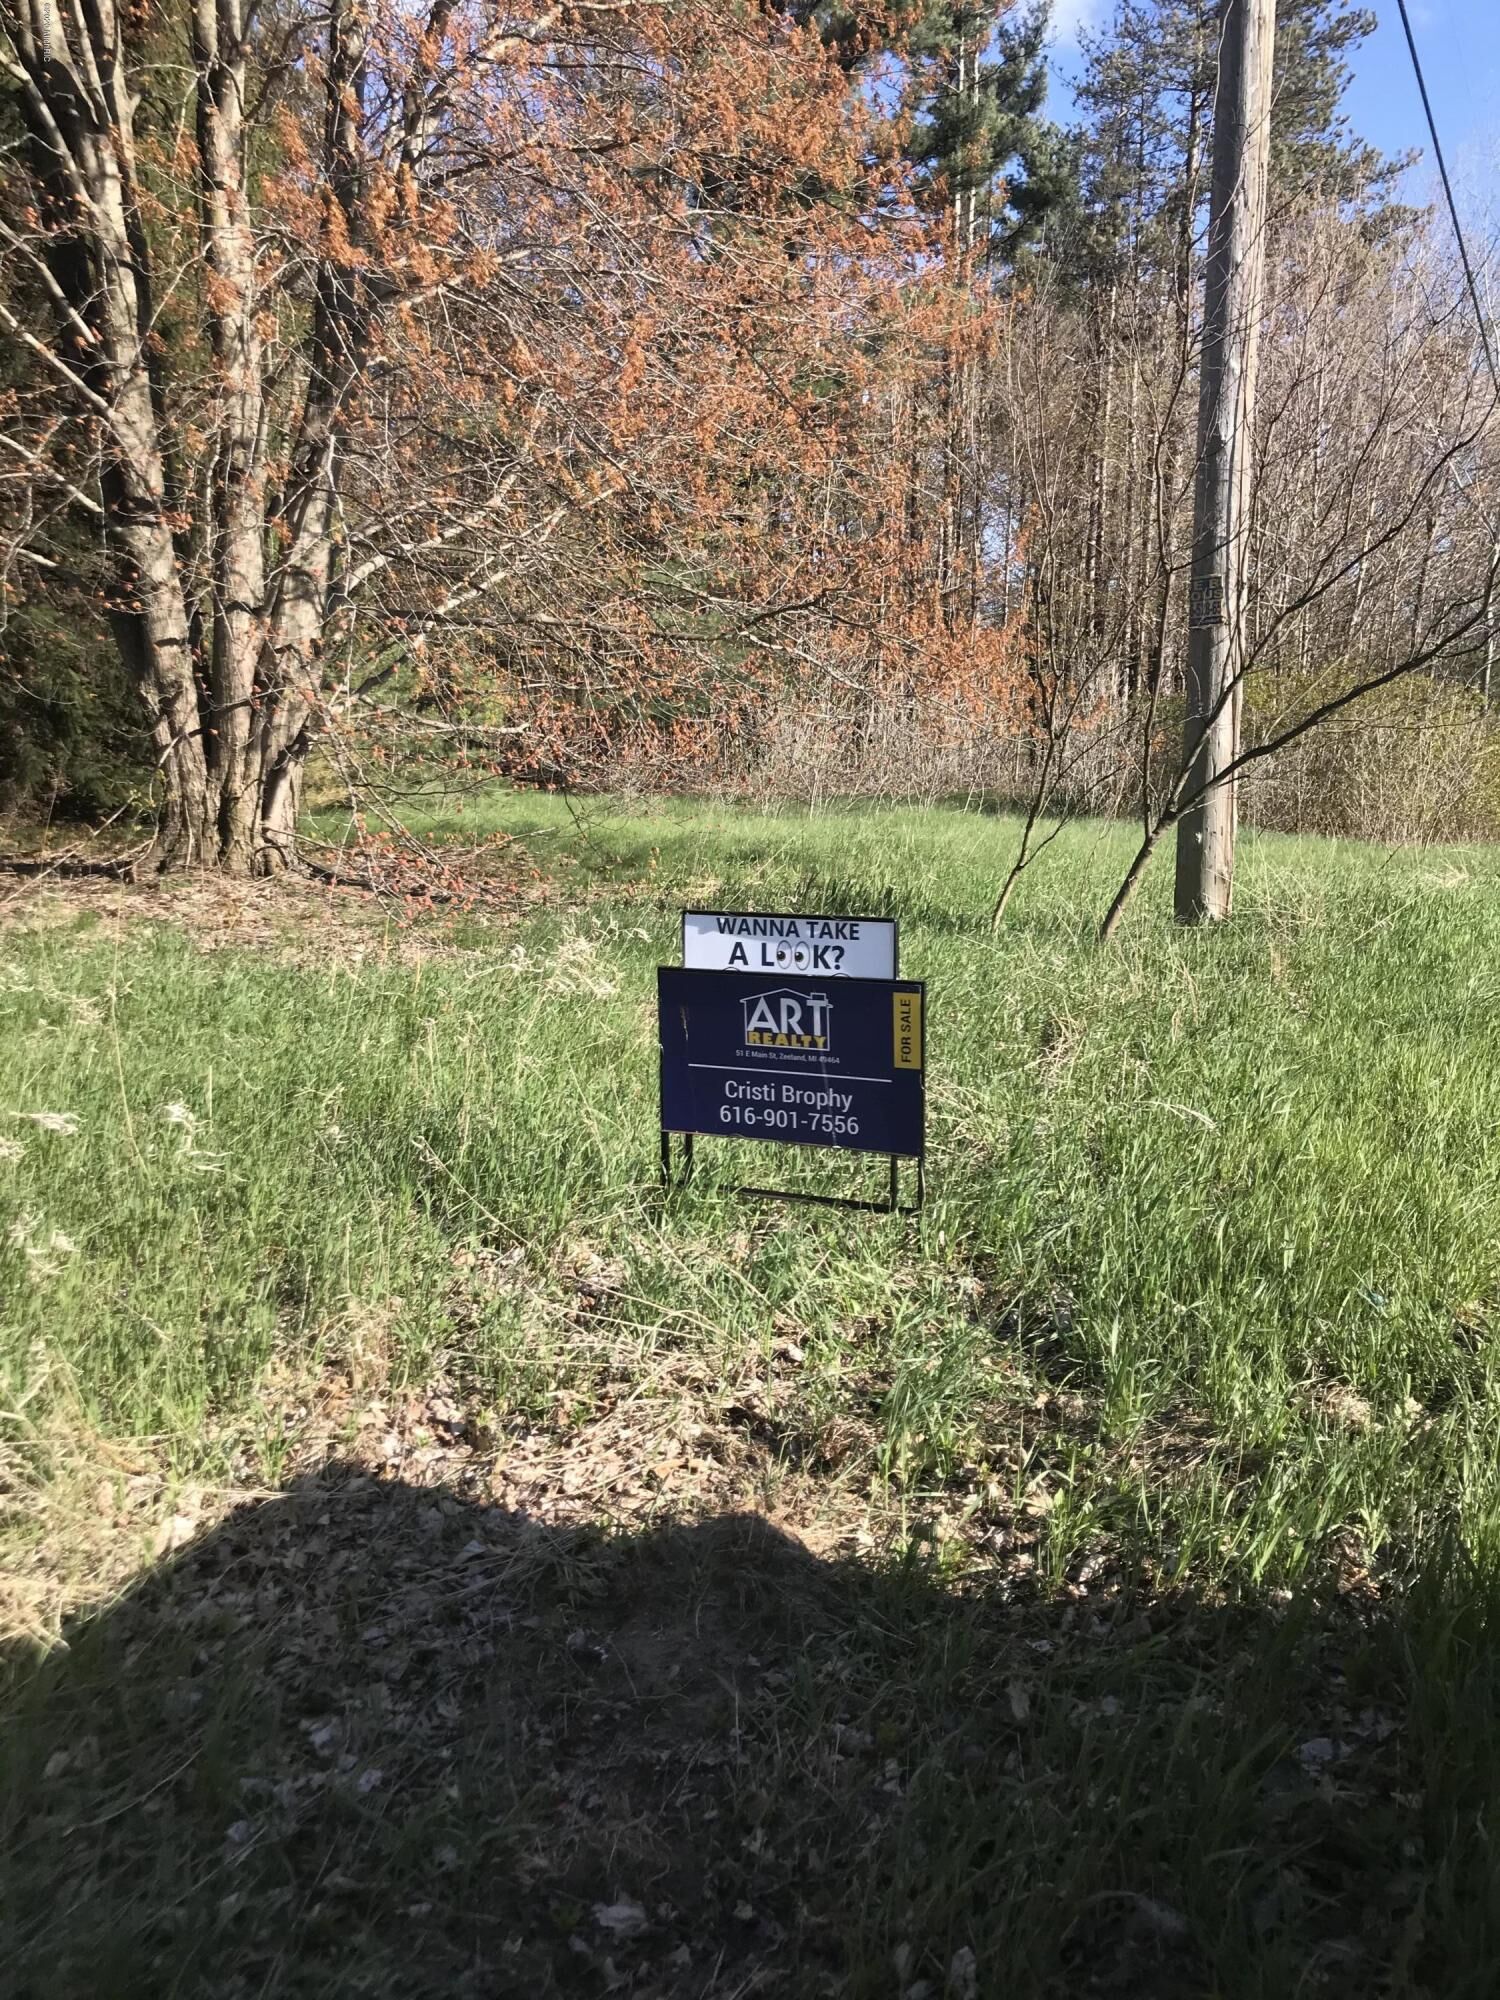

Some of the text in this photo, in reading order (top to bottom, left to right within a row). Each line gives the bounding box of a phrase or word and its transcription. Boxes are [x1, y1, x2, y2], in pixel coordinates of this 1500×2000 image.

[716, 917, 860, 941] WANNA TAKE
[728, 941, 749, 966] A
[747, 996, 829, 1037] ART
[748, 1031, 827, 1049] REALTY
[900, 998, 912, 1063] FOR SALE
[751, 1050, 768, 1059] Main
[725, 1080, 853, 1113] Cristi Brophy
[720, 1105, 859, 1135] 616-901-7556
